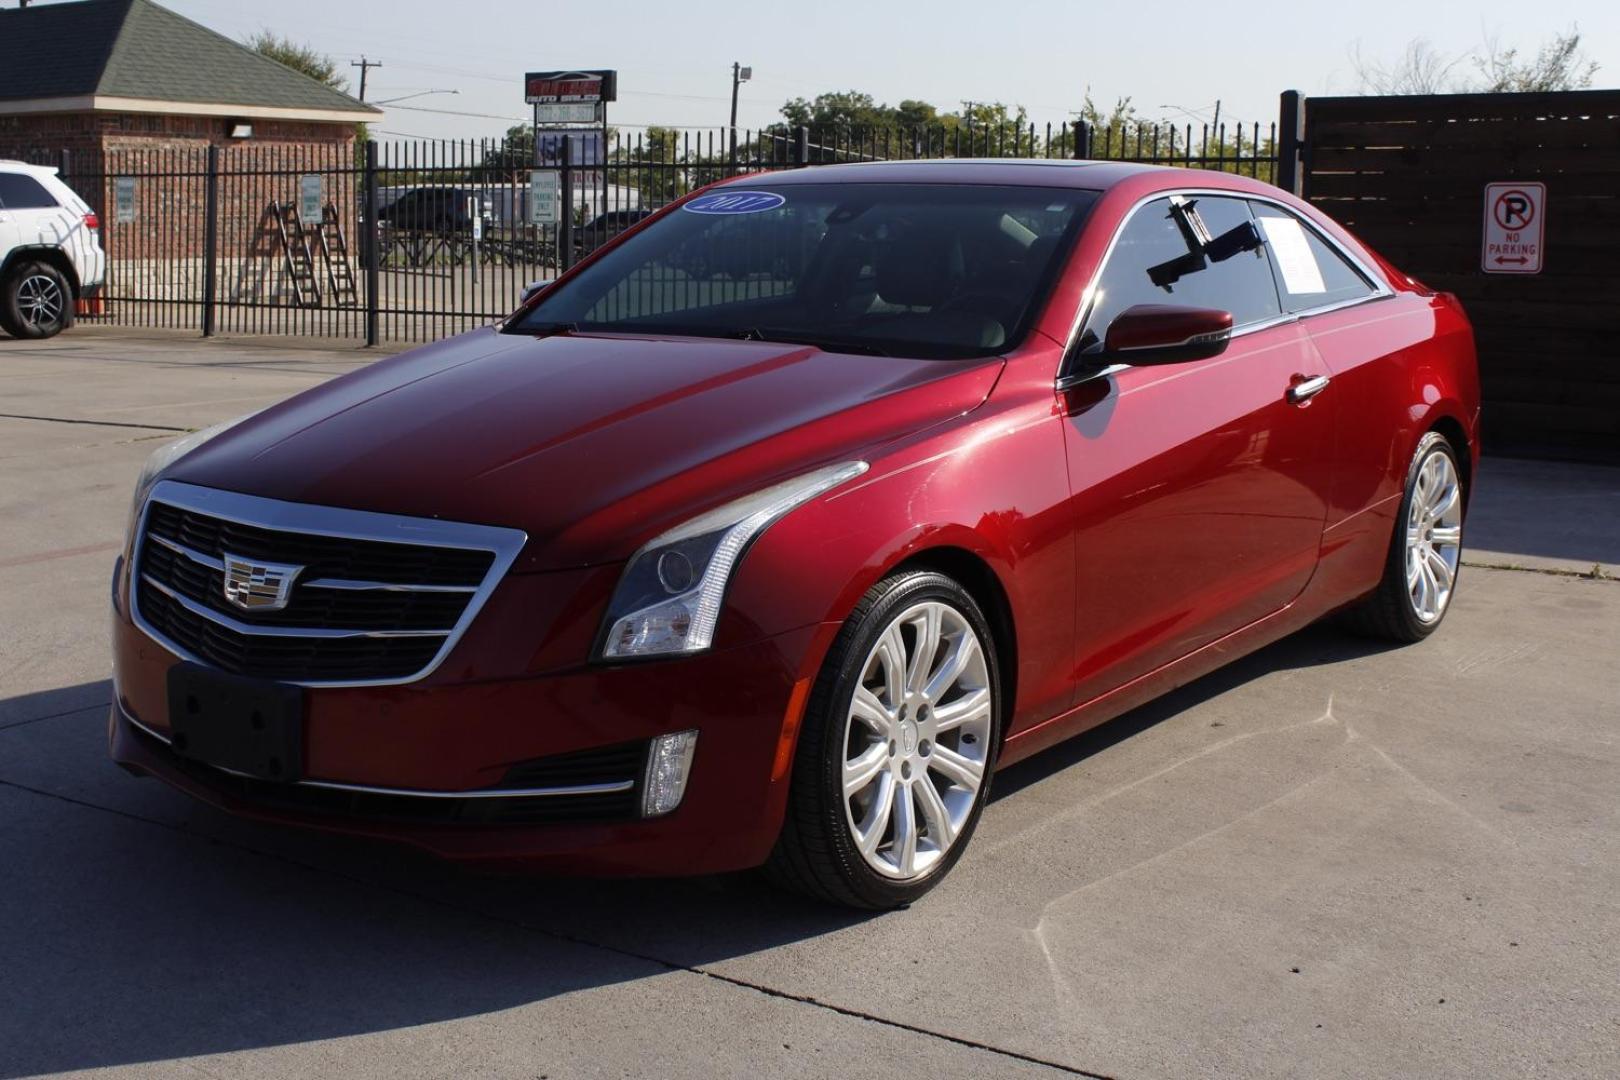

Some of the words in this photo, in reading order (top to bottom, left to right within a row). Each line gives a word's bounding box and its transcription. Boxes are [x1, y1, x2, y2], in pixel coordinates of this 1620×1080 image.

[692, 196, 777, 210] 2017
[1506, 232, 1520, 243] NO
[1488, 243, 1536, 256] PARKING
